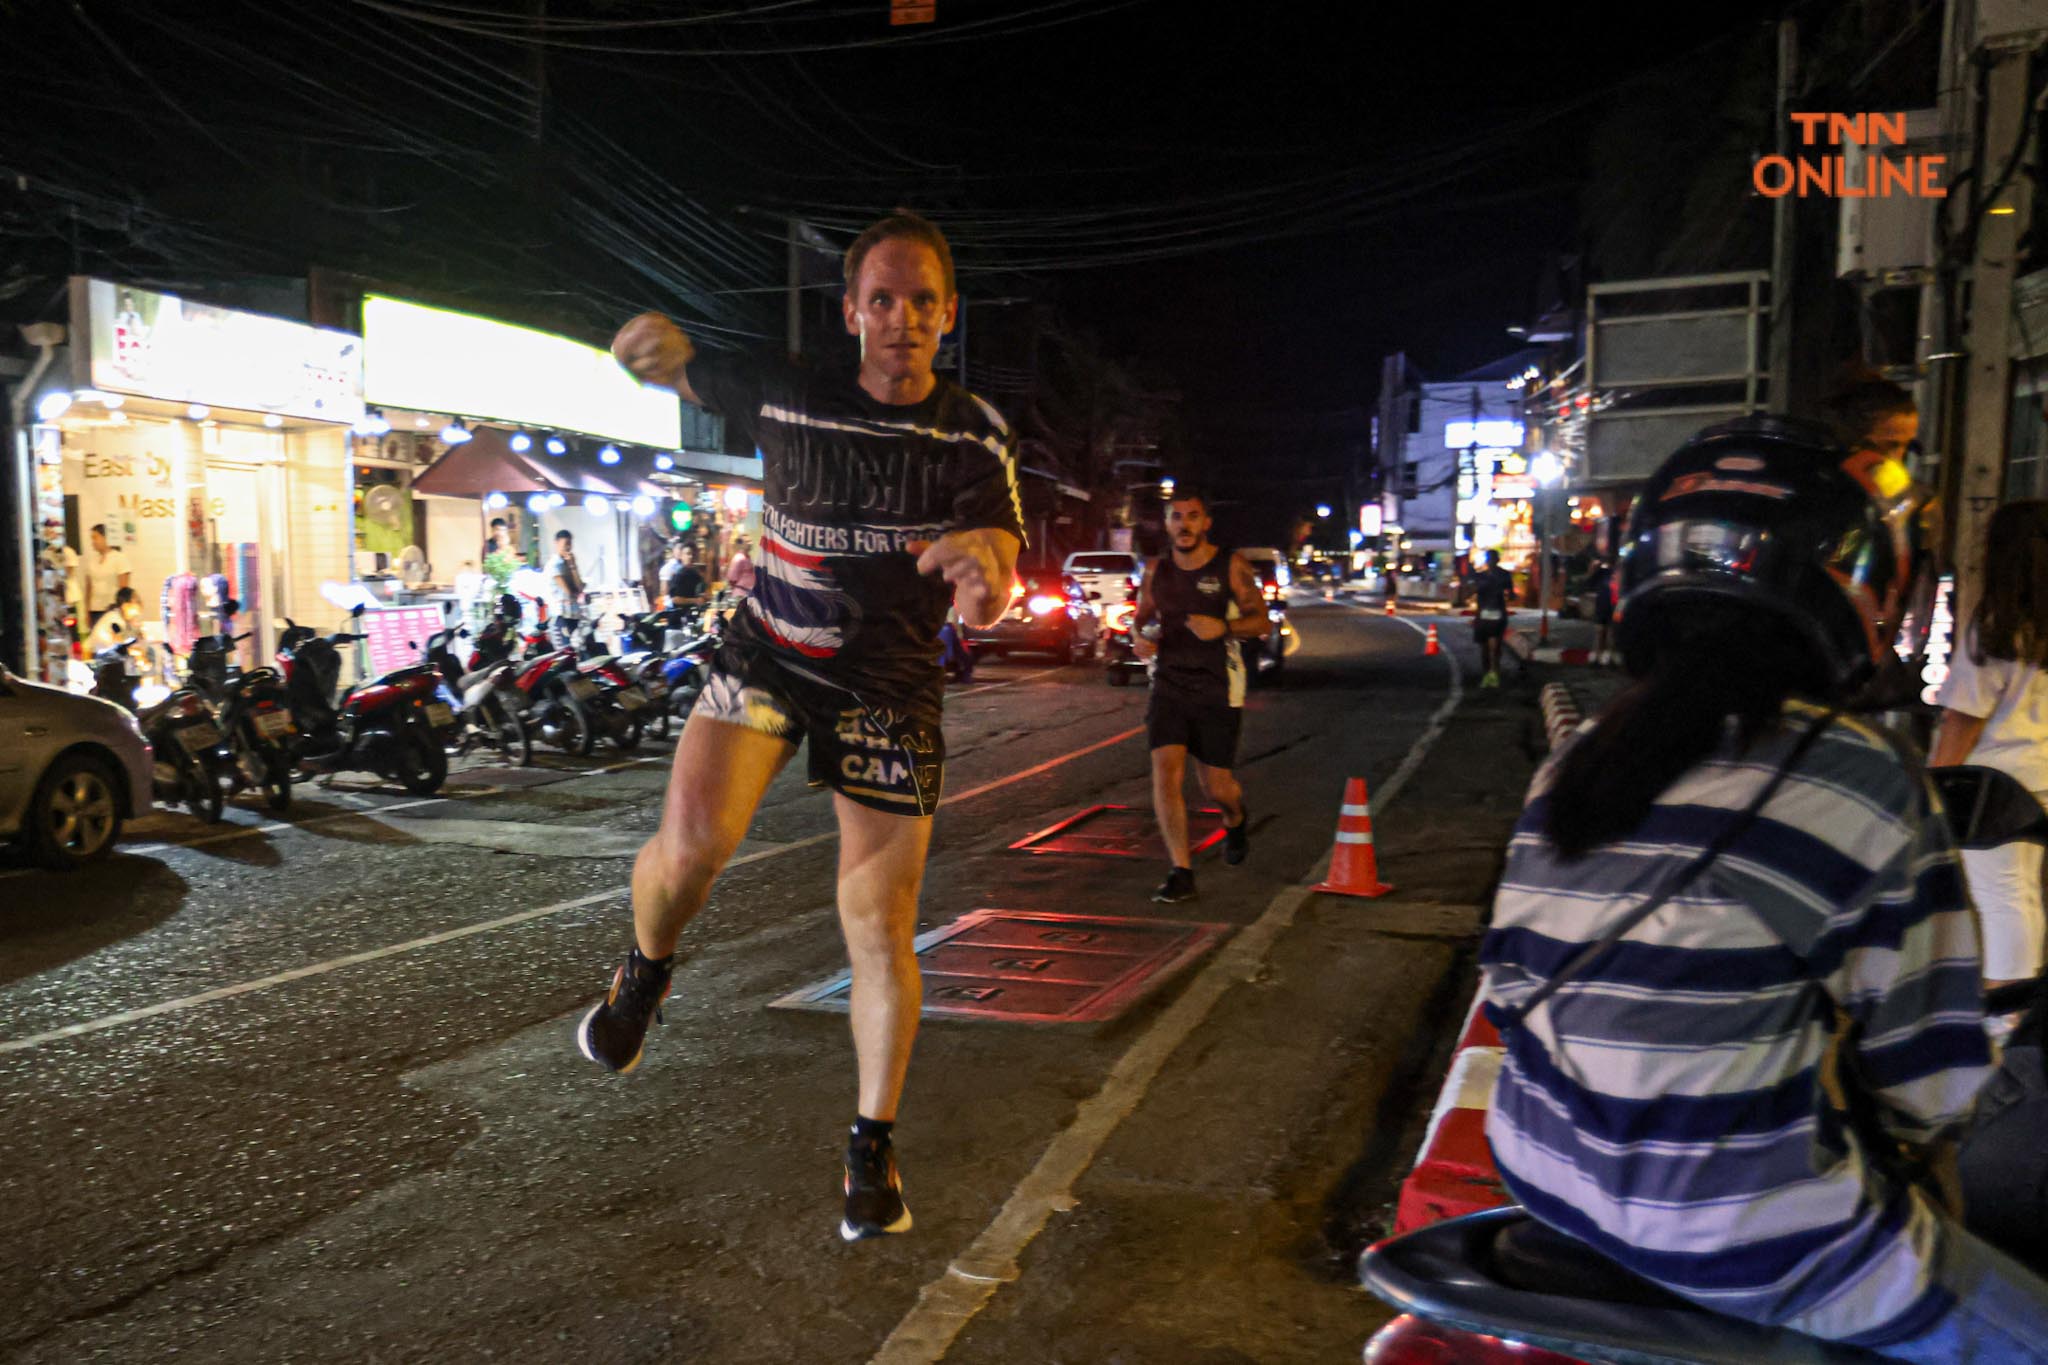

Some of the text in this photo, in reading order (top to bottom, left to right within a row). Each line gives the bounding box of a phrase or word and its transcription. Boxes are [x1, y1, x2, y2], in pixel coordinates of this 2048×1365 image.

[118, 494, 225, 518] Masse
[780, 513, 849, 551] FGHTERS
[854, 529, 891, 553] FOR
